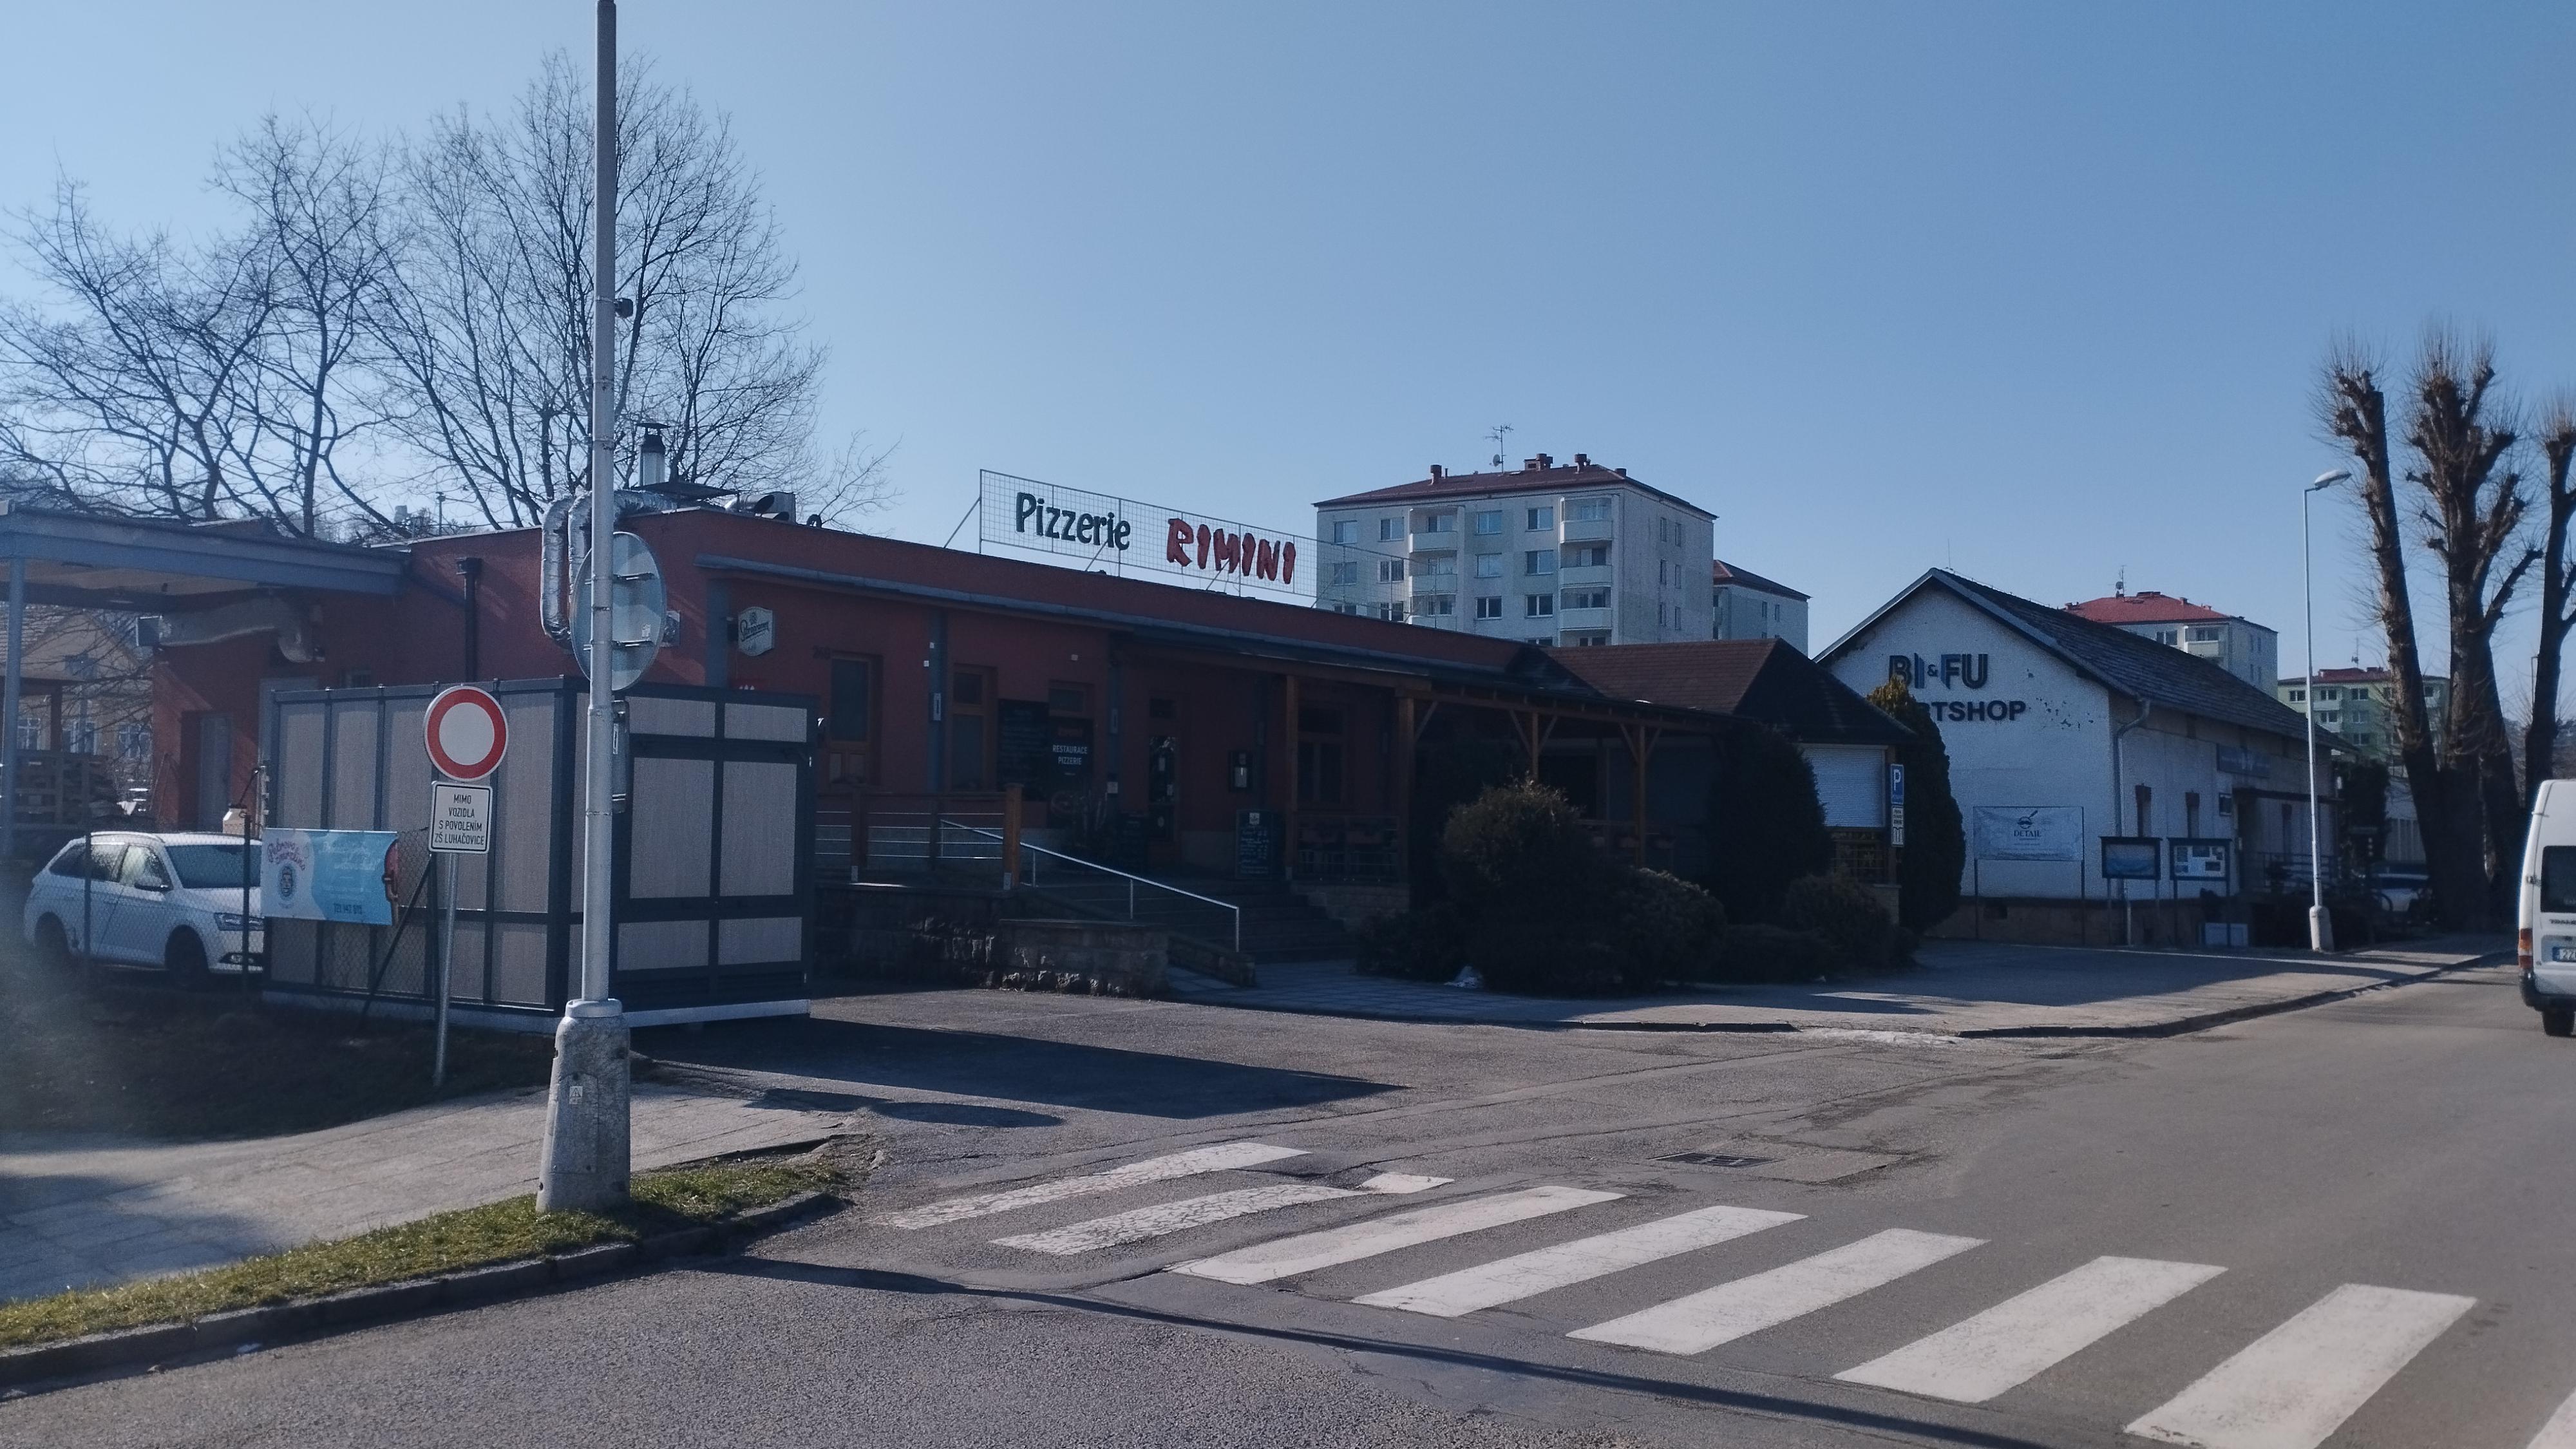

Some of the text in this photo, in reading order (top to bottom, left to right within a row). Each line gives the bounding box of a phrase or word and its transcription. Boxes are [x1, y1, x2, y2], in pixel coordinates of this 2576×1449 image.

[1016, 492, 1296, 585] Pizzerie RIMINI
[1052, 744, 1088, 755] RESTAURACE
[1057, 755, 1083, 766] PIZZERIE
[1893, 768, 1901, 791] P
[453, 793, 472, 804] MIMO
[448, 806, 475, 818] VOZIDLA
[439, 820, 482, 832] S POVOLENÍM
[434, 831, 485, 846] ZŠ LUHAČOVICE
